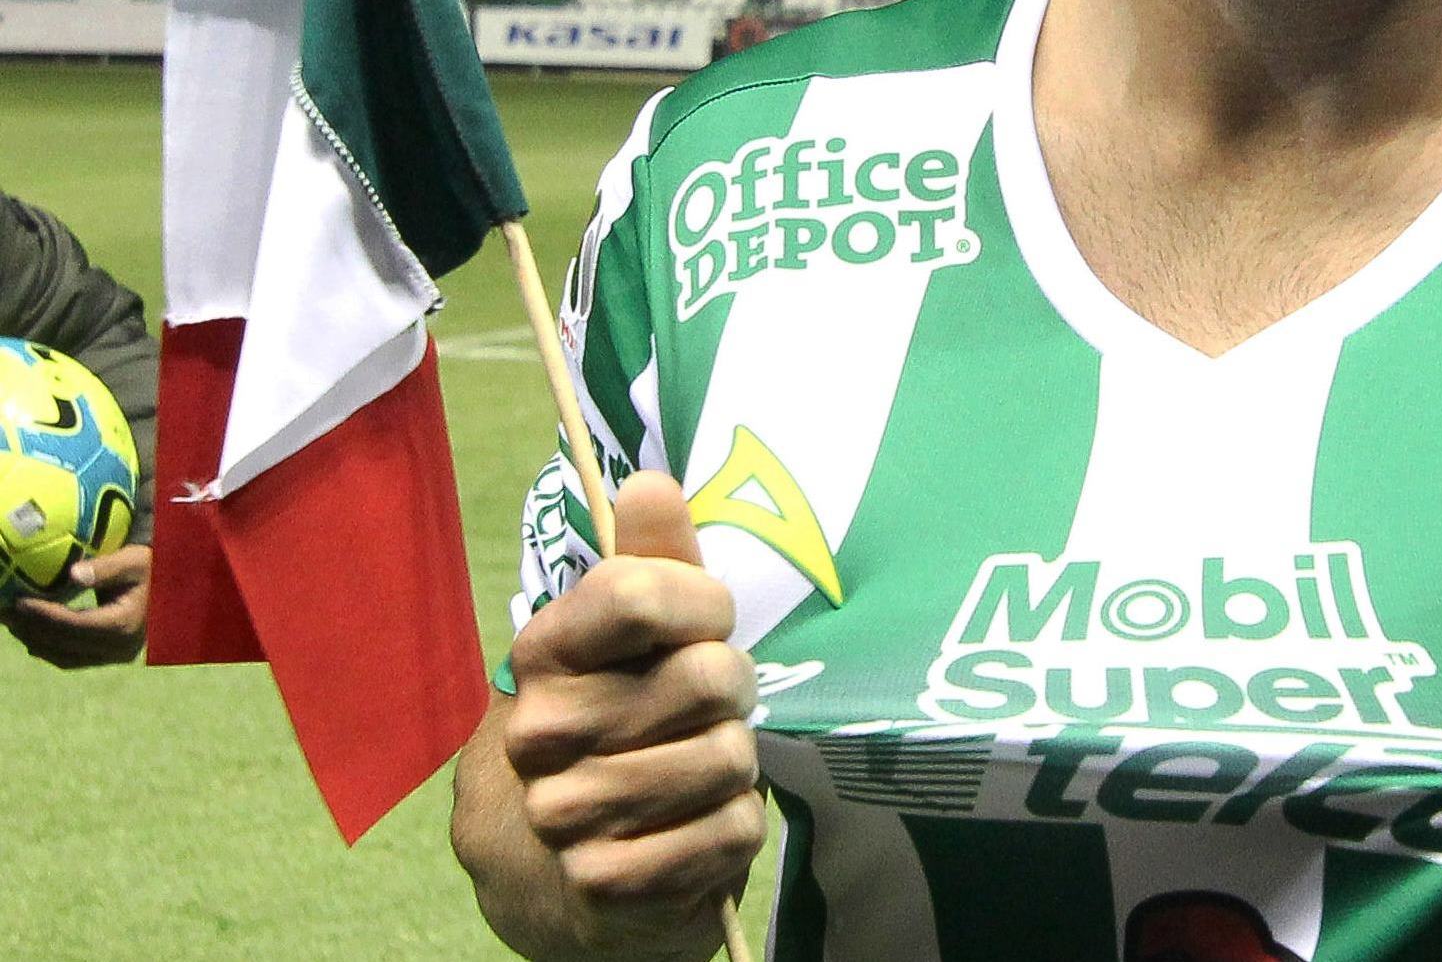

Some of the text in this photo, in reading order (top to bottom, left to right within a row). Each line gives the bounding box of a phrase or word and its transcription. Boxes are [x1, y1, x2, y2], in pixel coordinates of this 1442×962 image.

[674, 137, 959, 248] Office
[683, 205, 956, 311] DEPOT
[957, 552, 1370, 644] Mobil
[934, 649, 1396, 726] Super
